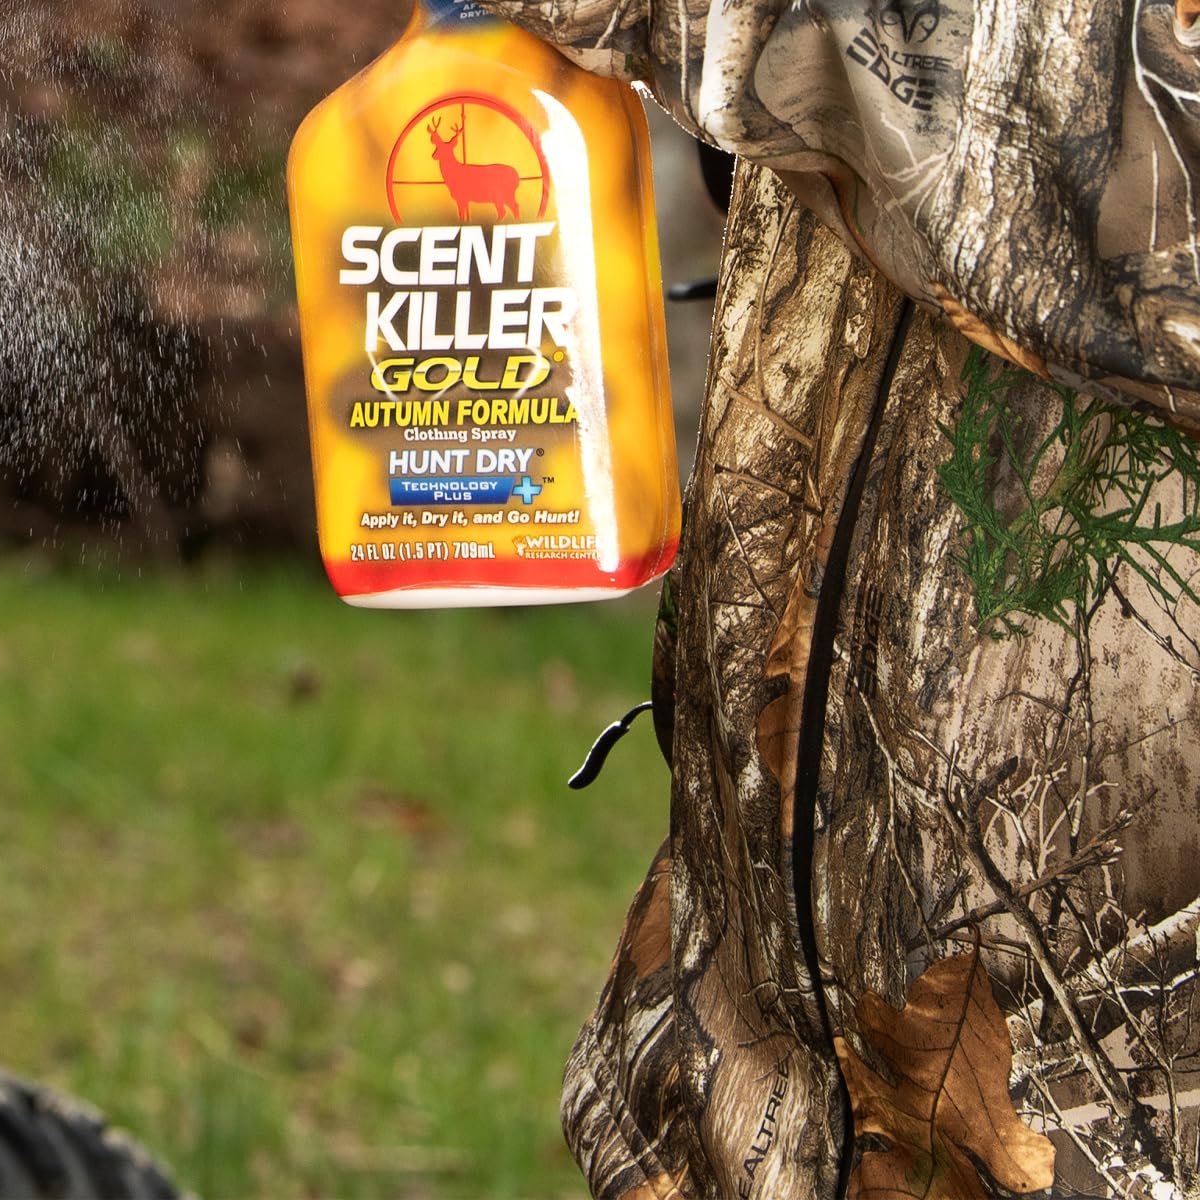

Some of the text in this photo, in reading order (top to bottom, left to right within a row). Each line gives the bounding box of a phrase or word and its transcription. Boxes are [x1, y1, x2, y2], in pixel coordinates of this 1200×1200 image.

[460, 9, 490, 19] DRYI
[846, 27, 936, 111] EDGE
[880, 43, 954, 73] ALTREE
[339, 222, 556, 286] SCENT
[365, 287, 578, 352] KILLER
[370, 354, 552, 393] GOLD
[350, 397, 580, 428] AUTUMN FORMULA
[404, 427, 517, 442] Clothing Spray
[389, 448, 534, 475] HUNT DRY
[402, 481, 498, 491] TECHNOLOGY
[434, 491, 472, 501] PLUS
[361, 510, 580, 529] Apply it, Dry it, and Go Hunt!
[350, 542, 496, 561] 24 FL OZ (1.5 PT) 709mL
[525, 535, 597, 550] WILDLIF
[525, 551, 568, 560] RESEARCH
[738, 1057, 790, 1200] EALTREE
